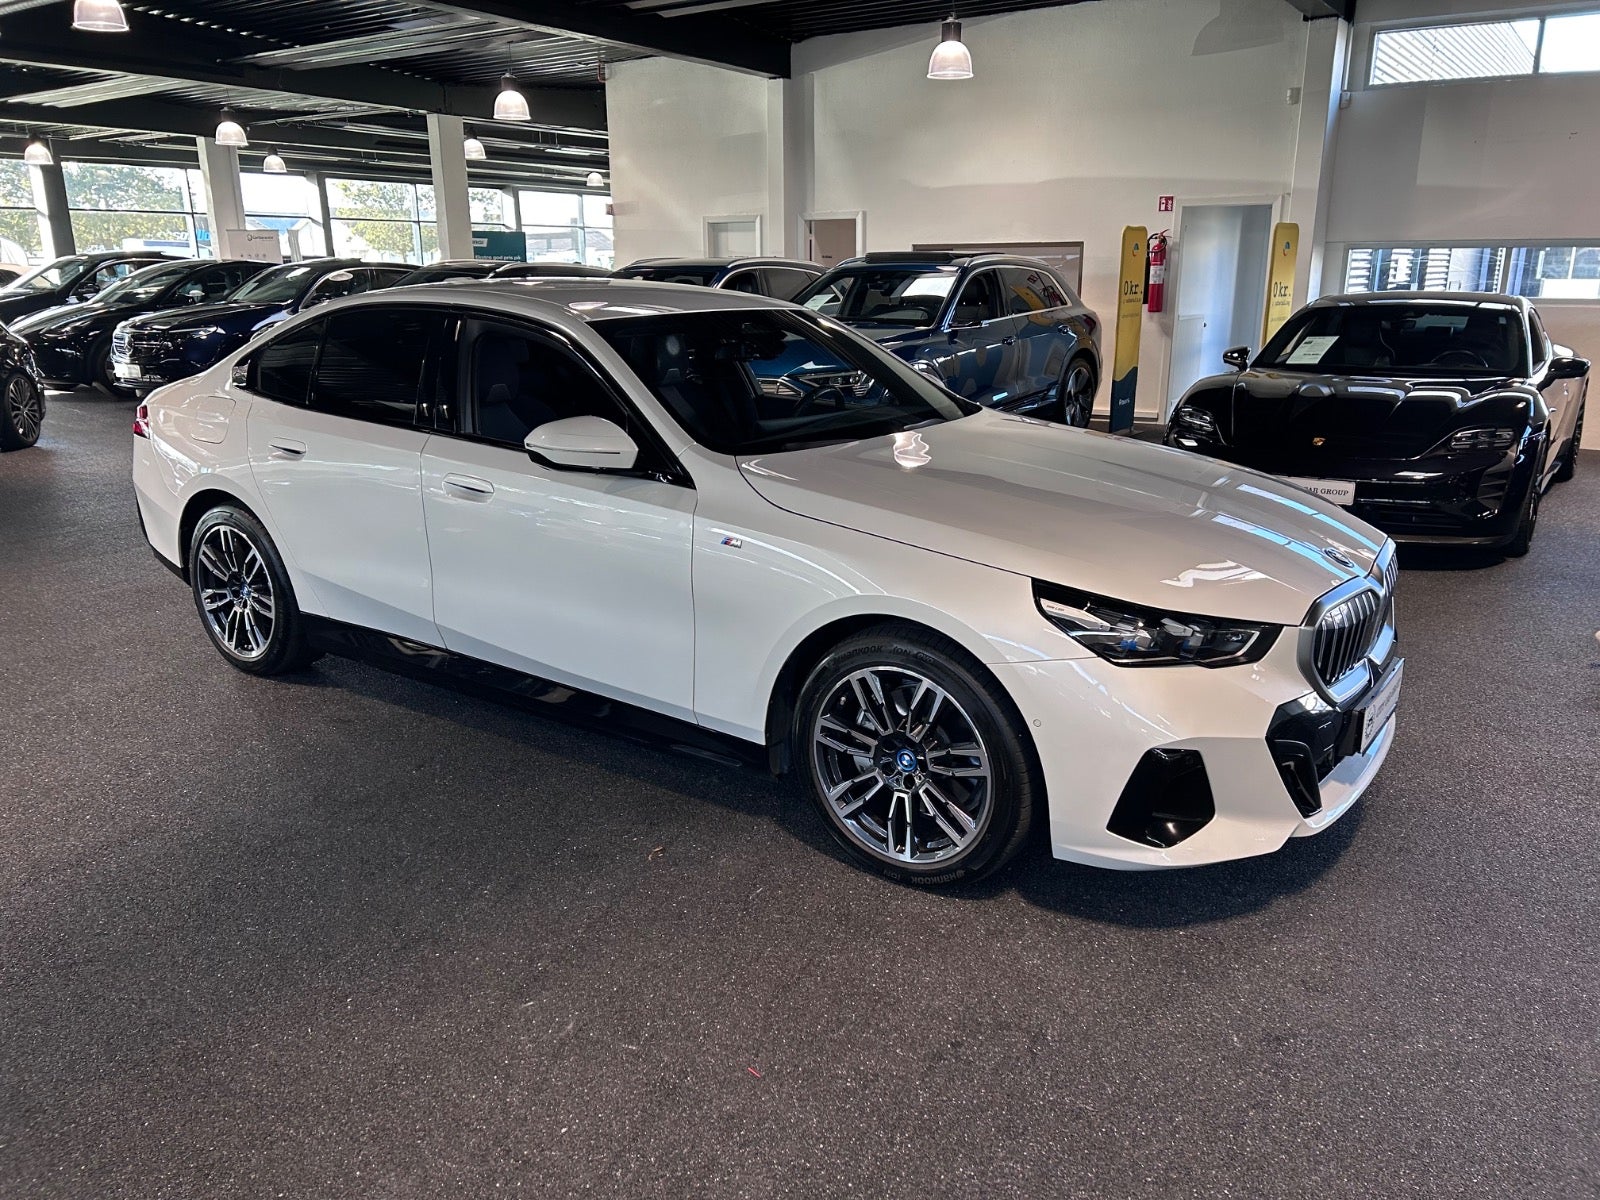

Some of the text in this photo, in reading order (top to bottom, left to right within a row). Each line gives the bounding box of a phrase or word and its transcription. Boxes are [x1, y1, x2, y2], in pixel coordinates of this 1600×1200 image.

[1123, 280, 1143, 295] 0 kr.
[1273, 281, 1291, 298] 0 kr.
[1320, 488, 1349, 496] GROUP
